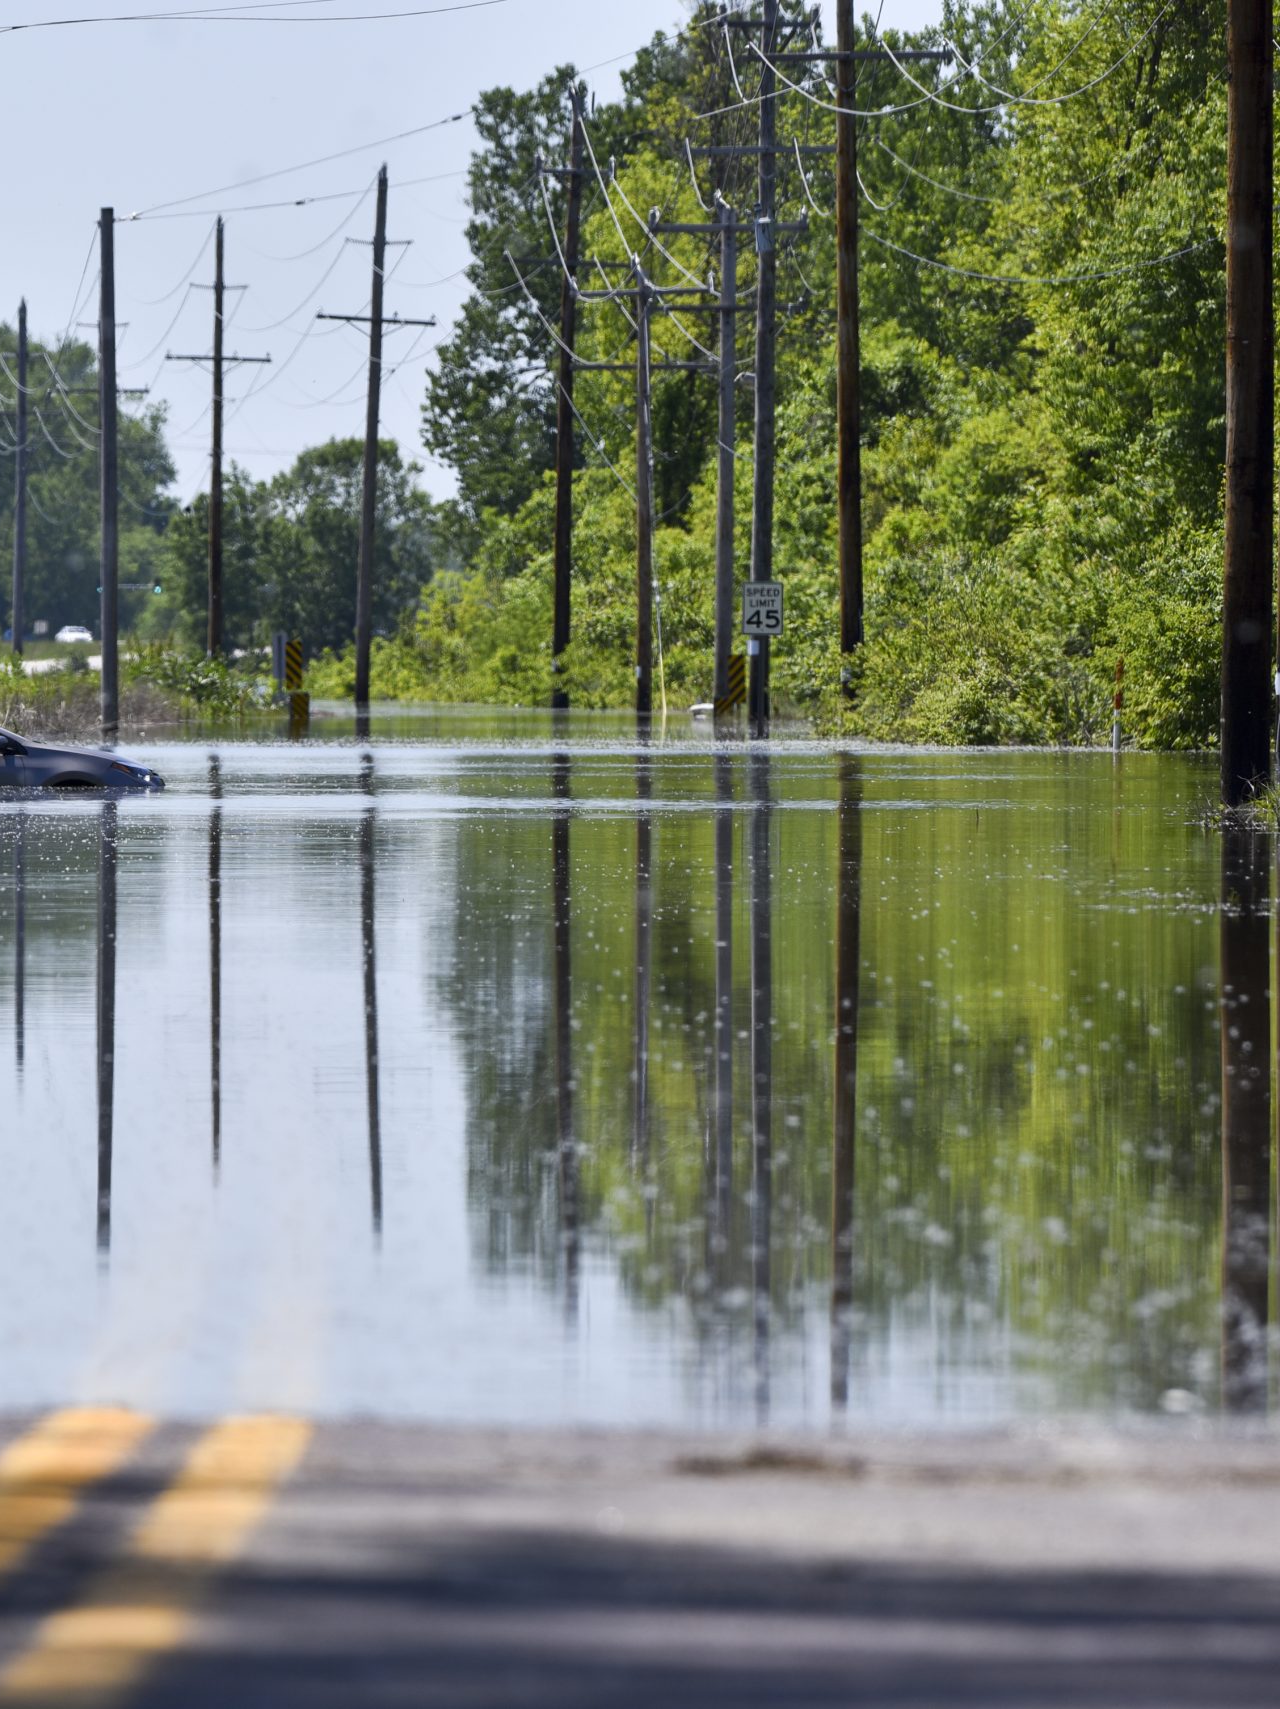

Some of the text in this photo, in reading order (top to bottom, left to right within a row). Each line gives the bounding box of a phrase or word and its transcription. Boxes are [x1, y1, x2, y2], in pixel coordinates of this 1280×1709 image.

[746, 588, 780, 597] SPEED
[750, 599, 776, 608] LIMIT
[746, 610, 780, 628] 45
